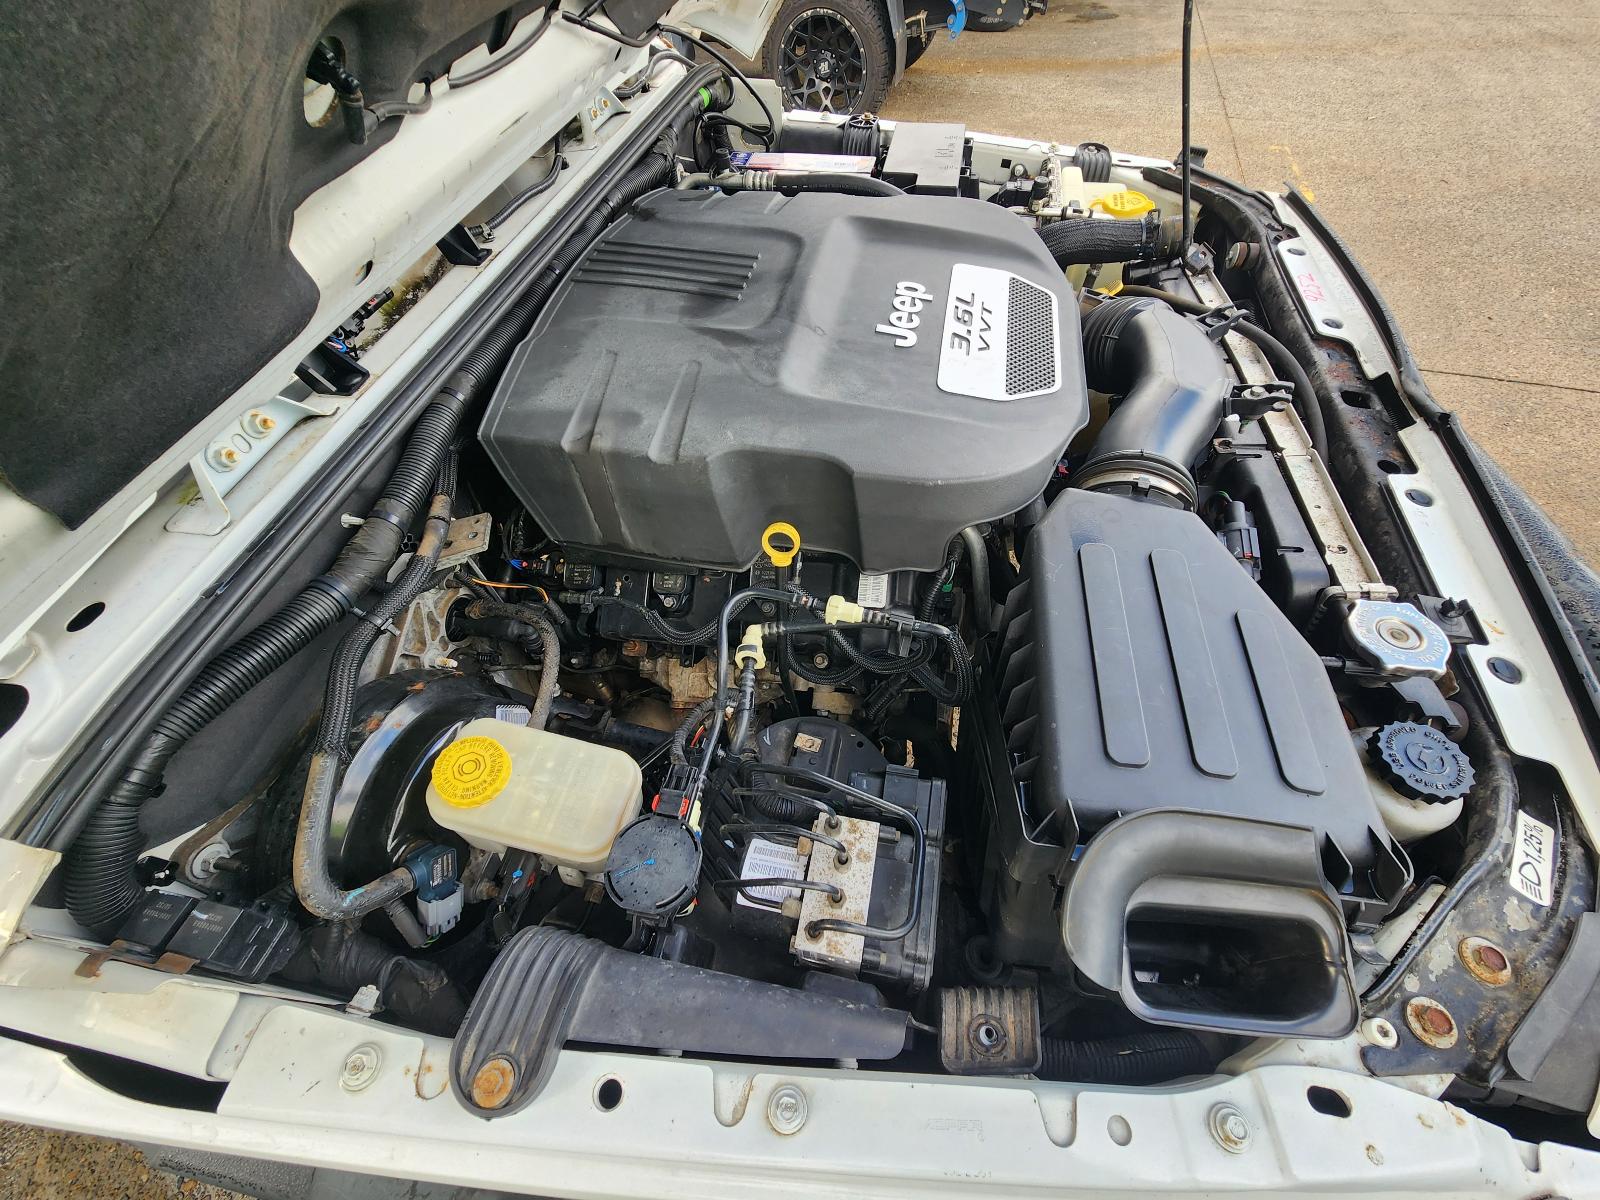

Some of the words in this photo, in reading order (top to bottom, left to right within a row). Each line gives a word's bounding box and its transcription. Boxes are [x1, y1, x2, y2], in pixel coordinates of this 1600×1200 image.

[875, 281, 933, 347] Jeep
[950, 292, 975, 356] 3.6L
[978, 301, 993, 352] VVT
[1522, 820, 1546, 864] 1,25%
